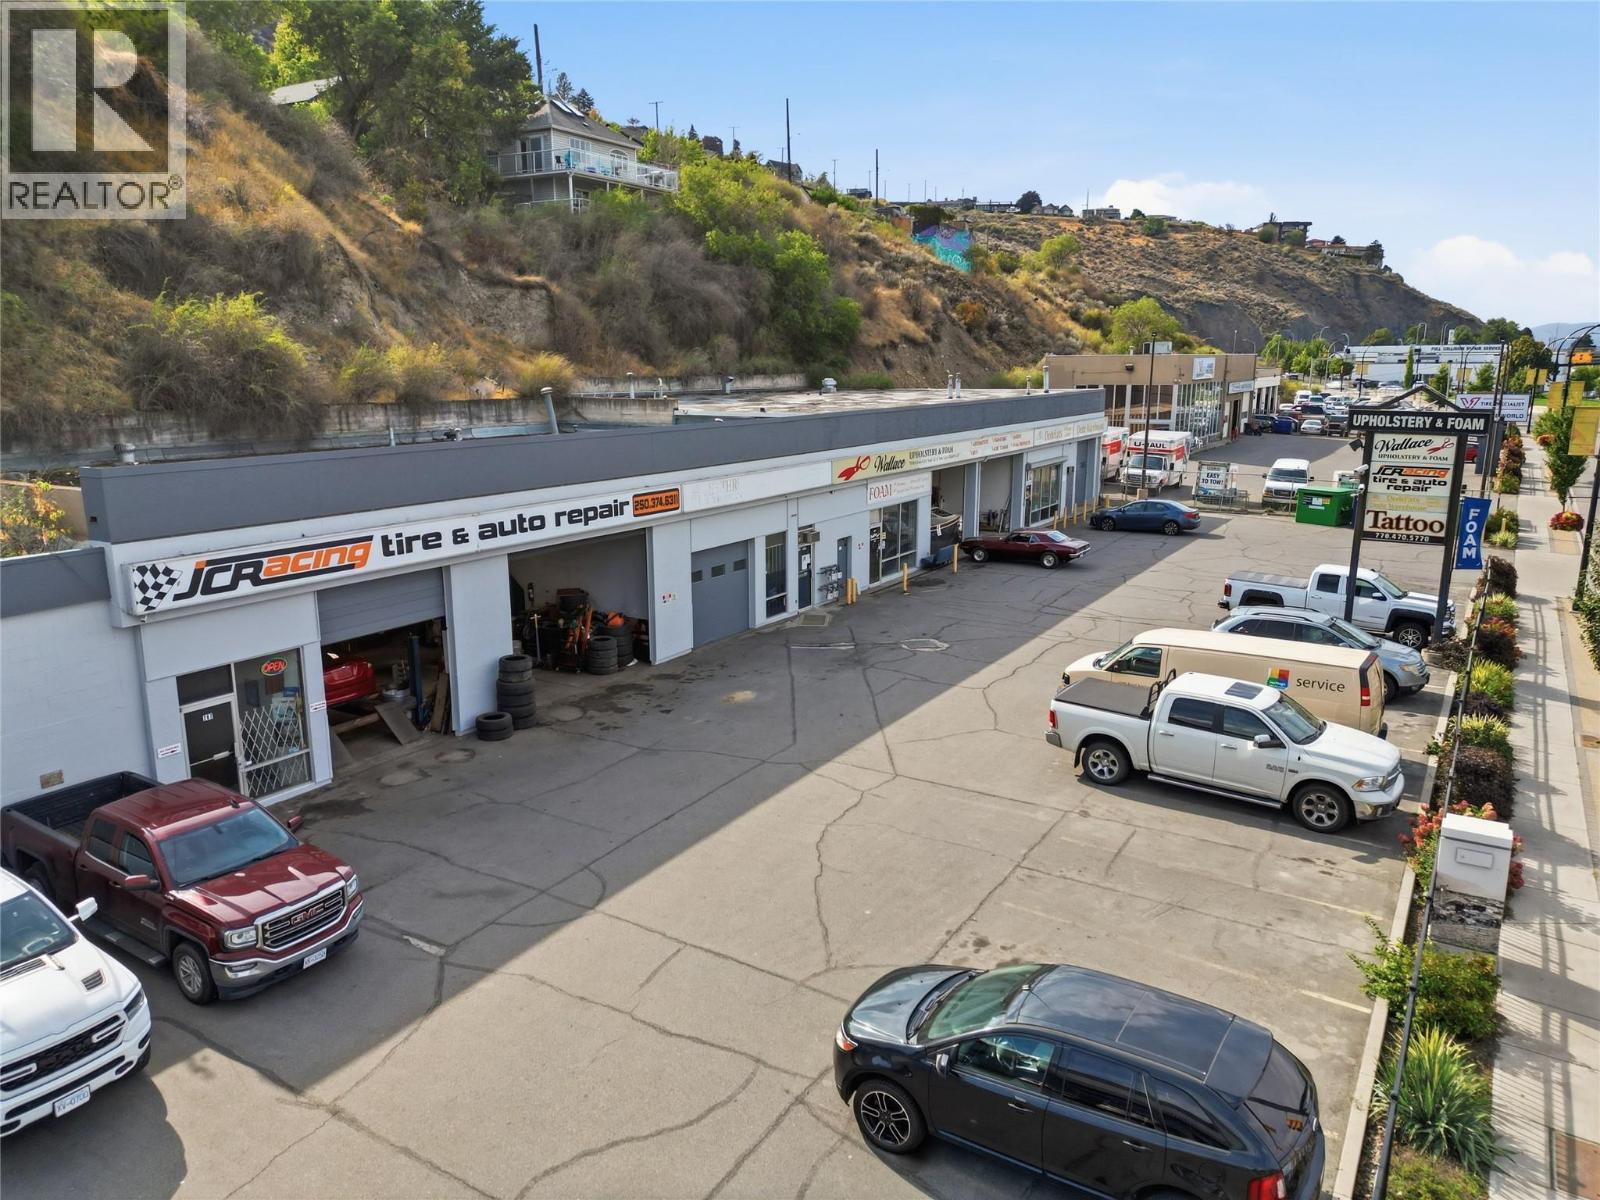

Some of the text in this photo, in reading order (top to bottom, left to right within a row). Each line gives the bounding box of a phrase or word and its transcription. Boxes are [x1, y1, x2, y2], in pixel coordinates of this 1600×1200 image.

[1352, 414, 1485, 430] UPHOLSTERY & FOAM
[1134, 441, 1167, 449] U-AUL
[1374, 437, 1434, 452] Wallace
[873, 454, 906, 473] Wallace
[1373, 475, 1398, 484] tire
[1412, 478, 1447, 486] auto
[869, 483, 892, 501] FOAM
[1386, 484, 1432, 493] repair
[381, 531, 442, 557] tire
[452, 527, 469, 545] &
[477, 513, 546, 541] auto
[554, 499, 630, 527] repair
[1366, 509, 1445, 534] Tattoo
[1462, 508, 1481, 559] FOAM
[262, 660, 286, 674] OPEN
[1295, 678, 1346, 693] service
